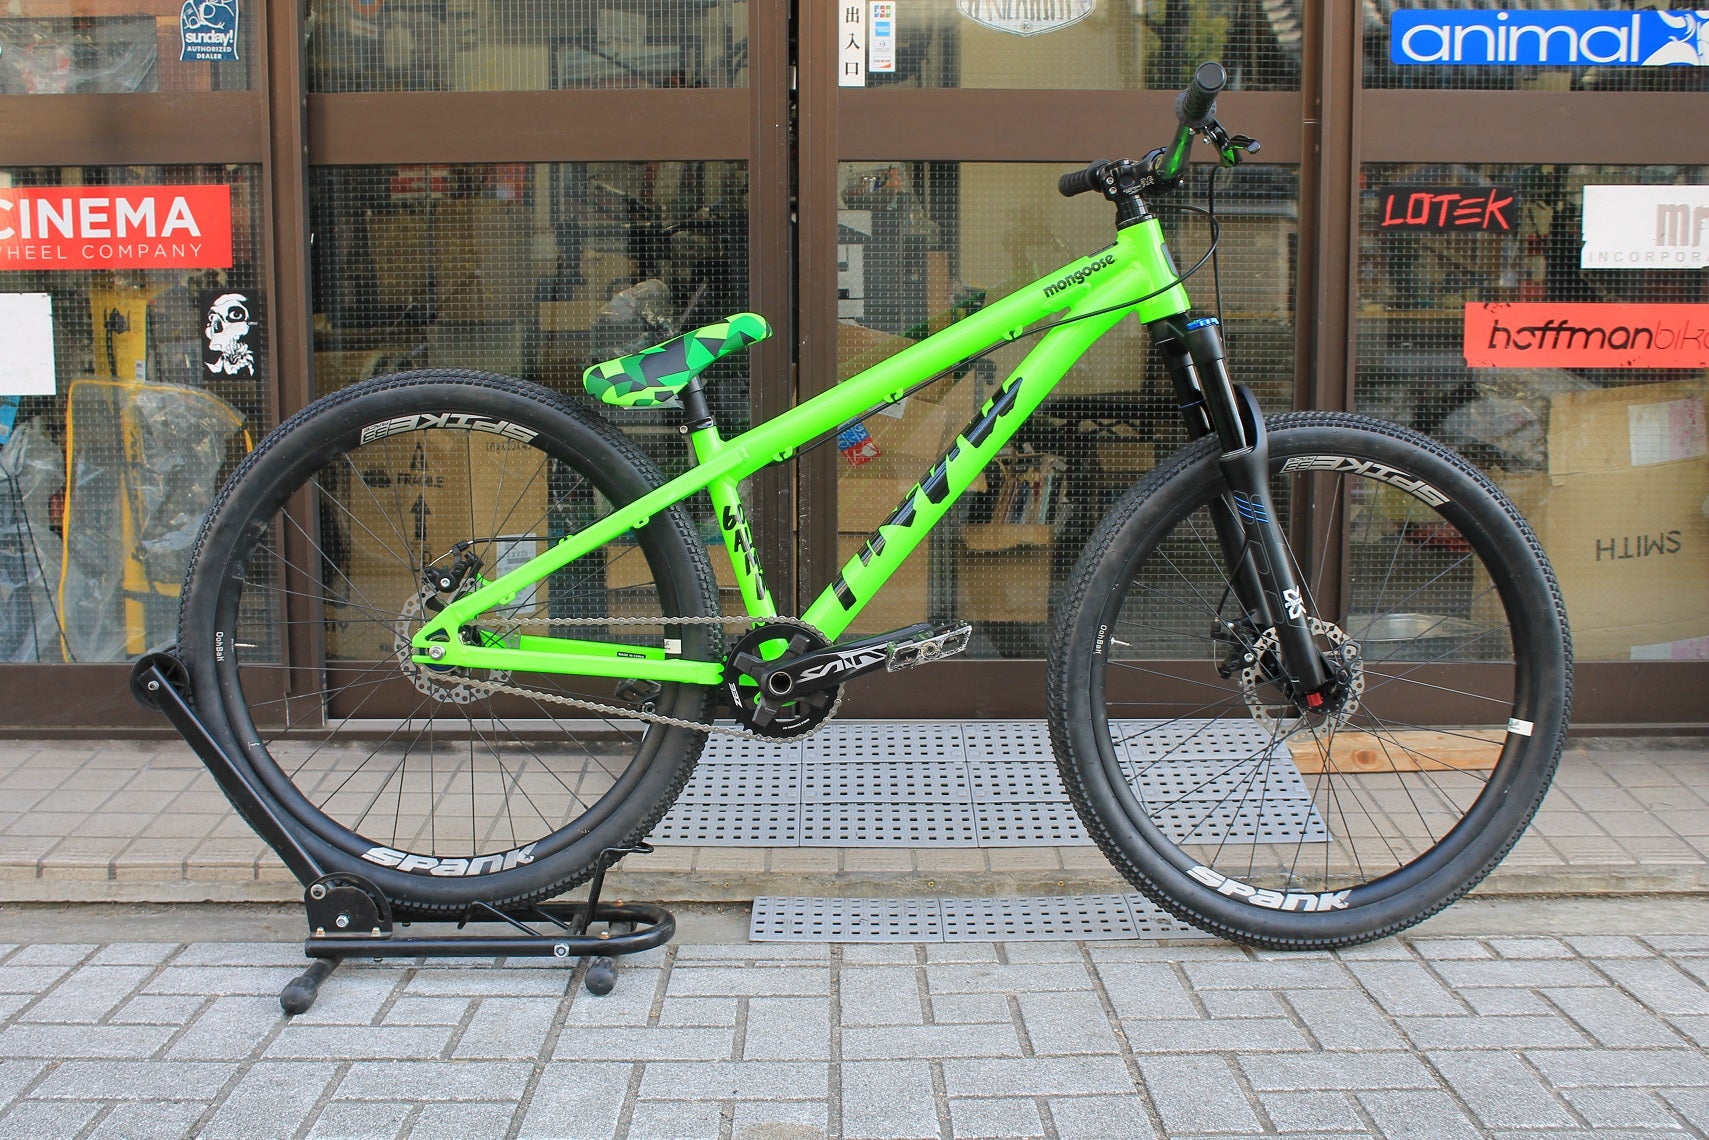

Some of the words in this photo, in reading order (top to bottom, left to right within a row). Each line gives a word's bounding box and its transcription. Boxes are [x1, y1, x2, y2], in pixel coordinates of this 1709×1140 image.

[185, 30, 233, 46] sunday!
[845, 6, 860, 75] 出入口
[1401, 12, 1641, 62] animal
[1381, 188, 1513, 230] LOTEK
[0, 245, 67, 259] HEEL
[82, 243, 202, 259] COMPANY
[1043, 254, 1116, 298] mongoose
[1488, 319, 1709, 351] hoffmanbik
[388, 413, 539, 444] SPIKE
[1306, 456, 1451, 507] SPIKE
[1596, 530, 1682, 561] SMITH
